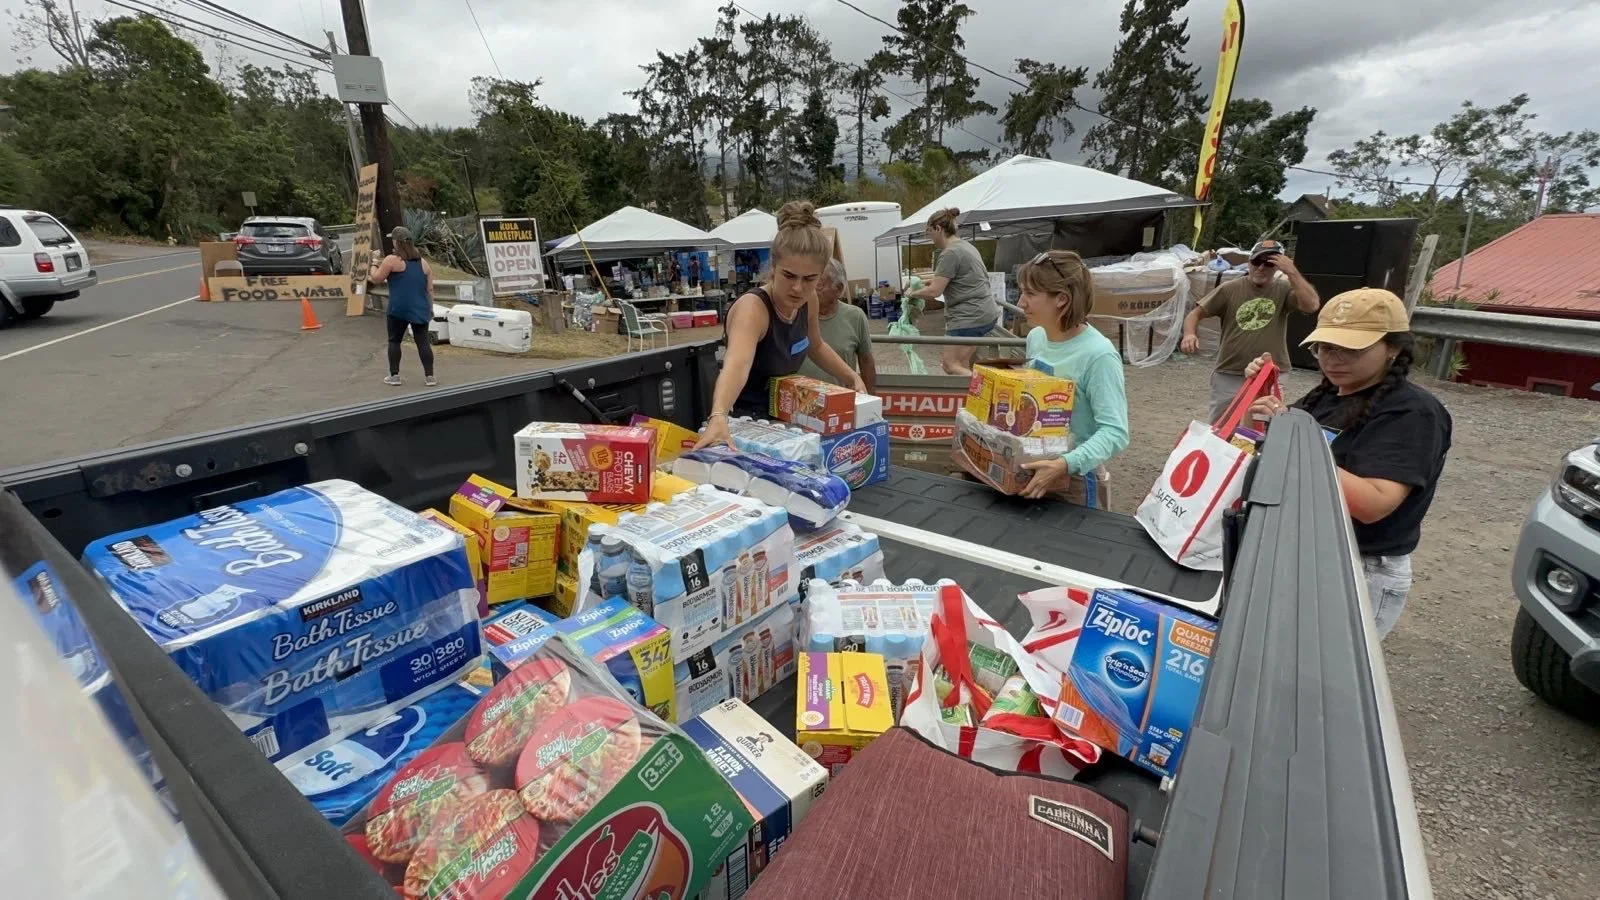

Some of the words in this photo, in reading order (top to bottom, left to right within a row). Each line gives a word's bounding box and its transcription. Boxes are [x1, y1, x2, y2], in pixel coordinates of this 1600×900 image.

[488, 231, 533, 241] MARKETPLACE
[500, 222, 519, 231] KULA
[494, 244, 531, 258] NOW
[494, 258, 537, 272] OPEN
[245, 276, 289, 287] FREE
[222, 287, 279, 300] FOOD
[557, 451, 567, 465] 42
[606, 471, 614, 493] BARS
[613, 450, 624, 494] PROTEIN
[624, 451, 634, 495] CHEWY
[660, 524, 719, 550] BODYARMOR
[798, 545, 826, 561] ARMOR
[686, 562, 698, 575] 20
[690, 577, 701, 588] 16
[801, 577, 810, 588] 20
[887, 584, 943, 593] ODYARMOR
[303, 589, 360, 615] KIRKLAND
[682, 588, 716, 608] BODYARMOR
[515, 611, 546, 632] NUTRI
[578, 604, 615, 625] Ziploc
[272, 617, 337, 660] Bath
[333, 601, 398, 635] Tissue
[502, 617, 535, 636] GRAIN
[609, 617, 645, 638] Ziploc
[1092, 607, 1152, 646] Ziploc
[1175, 626, 1214, 648] QUART
[410, 653, 432, 671] 30
[436, 637, 465, 660] 380
[509, 632, 550, 656] Ziploc
[844, 643, 858, 651] 20
[1175, 636, 1212, 655] FREEZER
[263, 647, 351, 706] Bath
[346, 622, 429, 667] Tissue
[412, 670, 437, 683] WIDE
[439, 652, 467, 672] SHEETS
[639, 643, 671, 671] 347
[696, 660, 709, 671] 16
[1165, 648, 1205, 676] 216
[413, 664, 432, 675] ROLLS
[1107, 664, 1142, 683] Technology
[1165, 665, 1184, 677] TOTAL
[1185, 670, 1201, 683] BAGS
[688, 669, 723, 694] BODYARMOR
[859, 675, 871, 693] TASTY
[723, 700, 738, 711] 48
[860, 691, 872, 705] BITE
[1149, 725, 1164, 736] STAY
[1163, 731, 1181, 743] OPEN
[536, 731, 565, 759] Bowl
[536, 738, 582, 769] Noodles
[736, 736, 762, 759] QUAKER
[304, 750, 355, 781] Soft
[706, 748, 739, 778] VARIETY
[714, 745, 744, 773] FLAVOR
[393, 769, 423, 792] Bowl
[644, 768, 659, 784] 3
[658, 759, 674, 775] min
[388, 777, 434, 801] Noodles
[814, 782, 825, 798] 48
[702, 802, 723, 824] 18
[709, 809, 728, 830] BOWLS
[1038, 805, 1106, 842] CABRINHA
[458, 831, 516, 881] Noodles
[480, 843, 518, 881] Bowl
[606, 840, 648, 900] imchi
